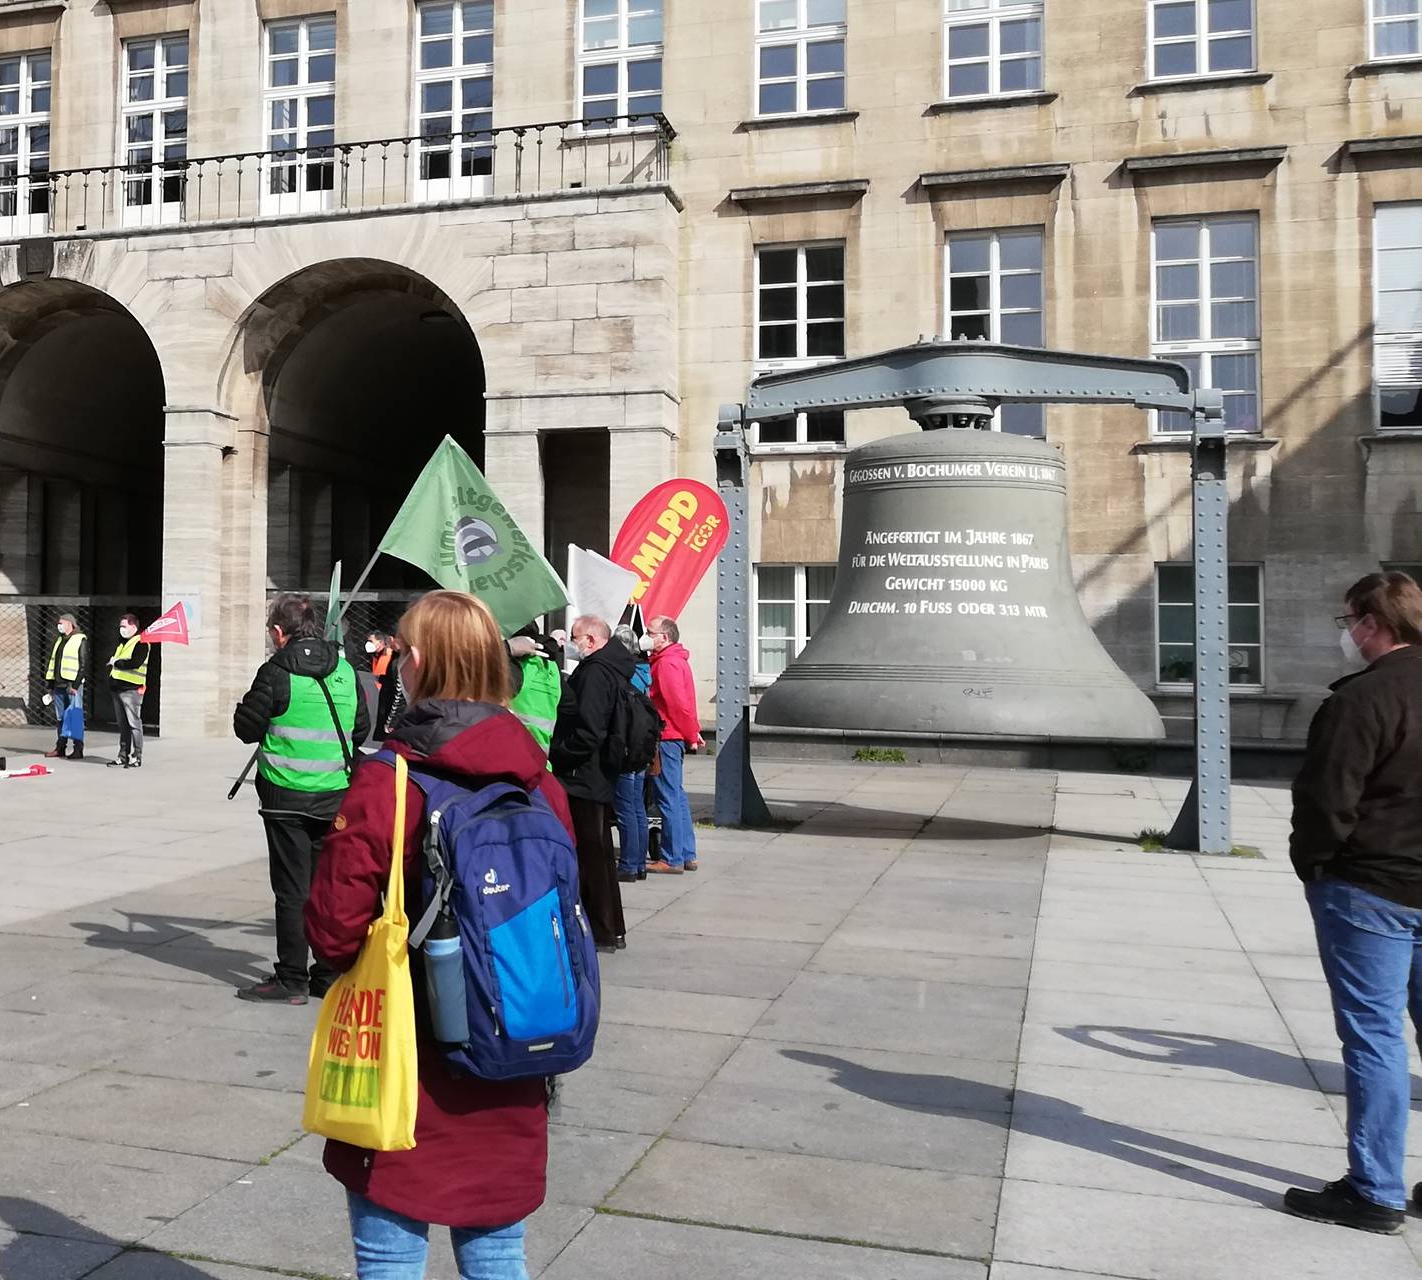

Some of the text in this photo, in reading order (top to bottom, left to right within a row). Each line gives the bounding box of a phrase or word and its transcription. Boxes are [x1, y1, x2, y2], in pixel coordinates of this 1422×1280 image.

[631, 490, 698, 579] MLPD
[690, 515, 721, 553] ICOR
[1010, 533, 1034, 546] 1867
[947, 578, 986, 592] 15000
[903, 602, 917, 614] 10
[482, 884, 510, 895] deuter
